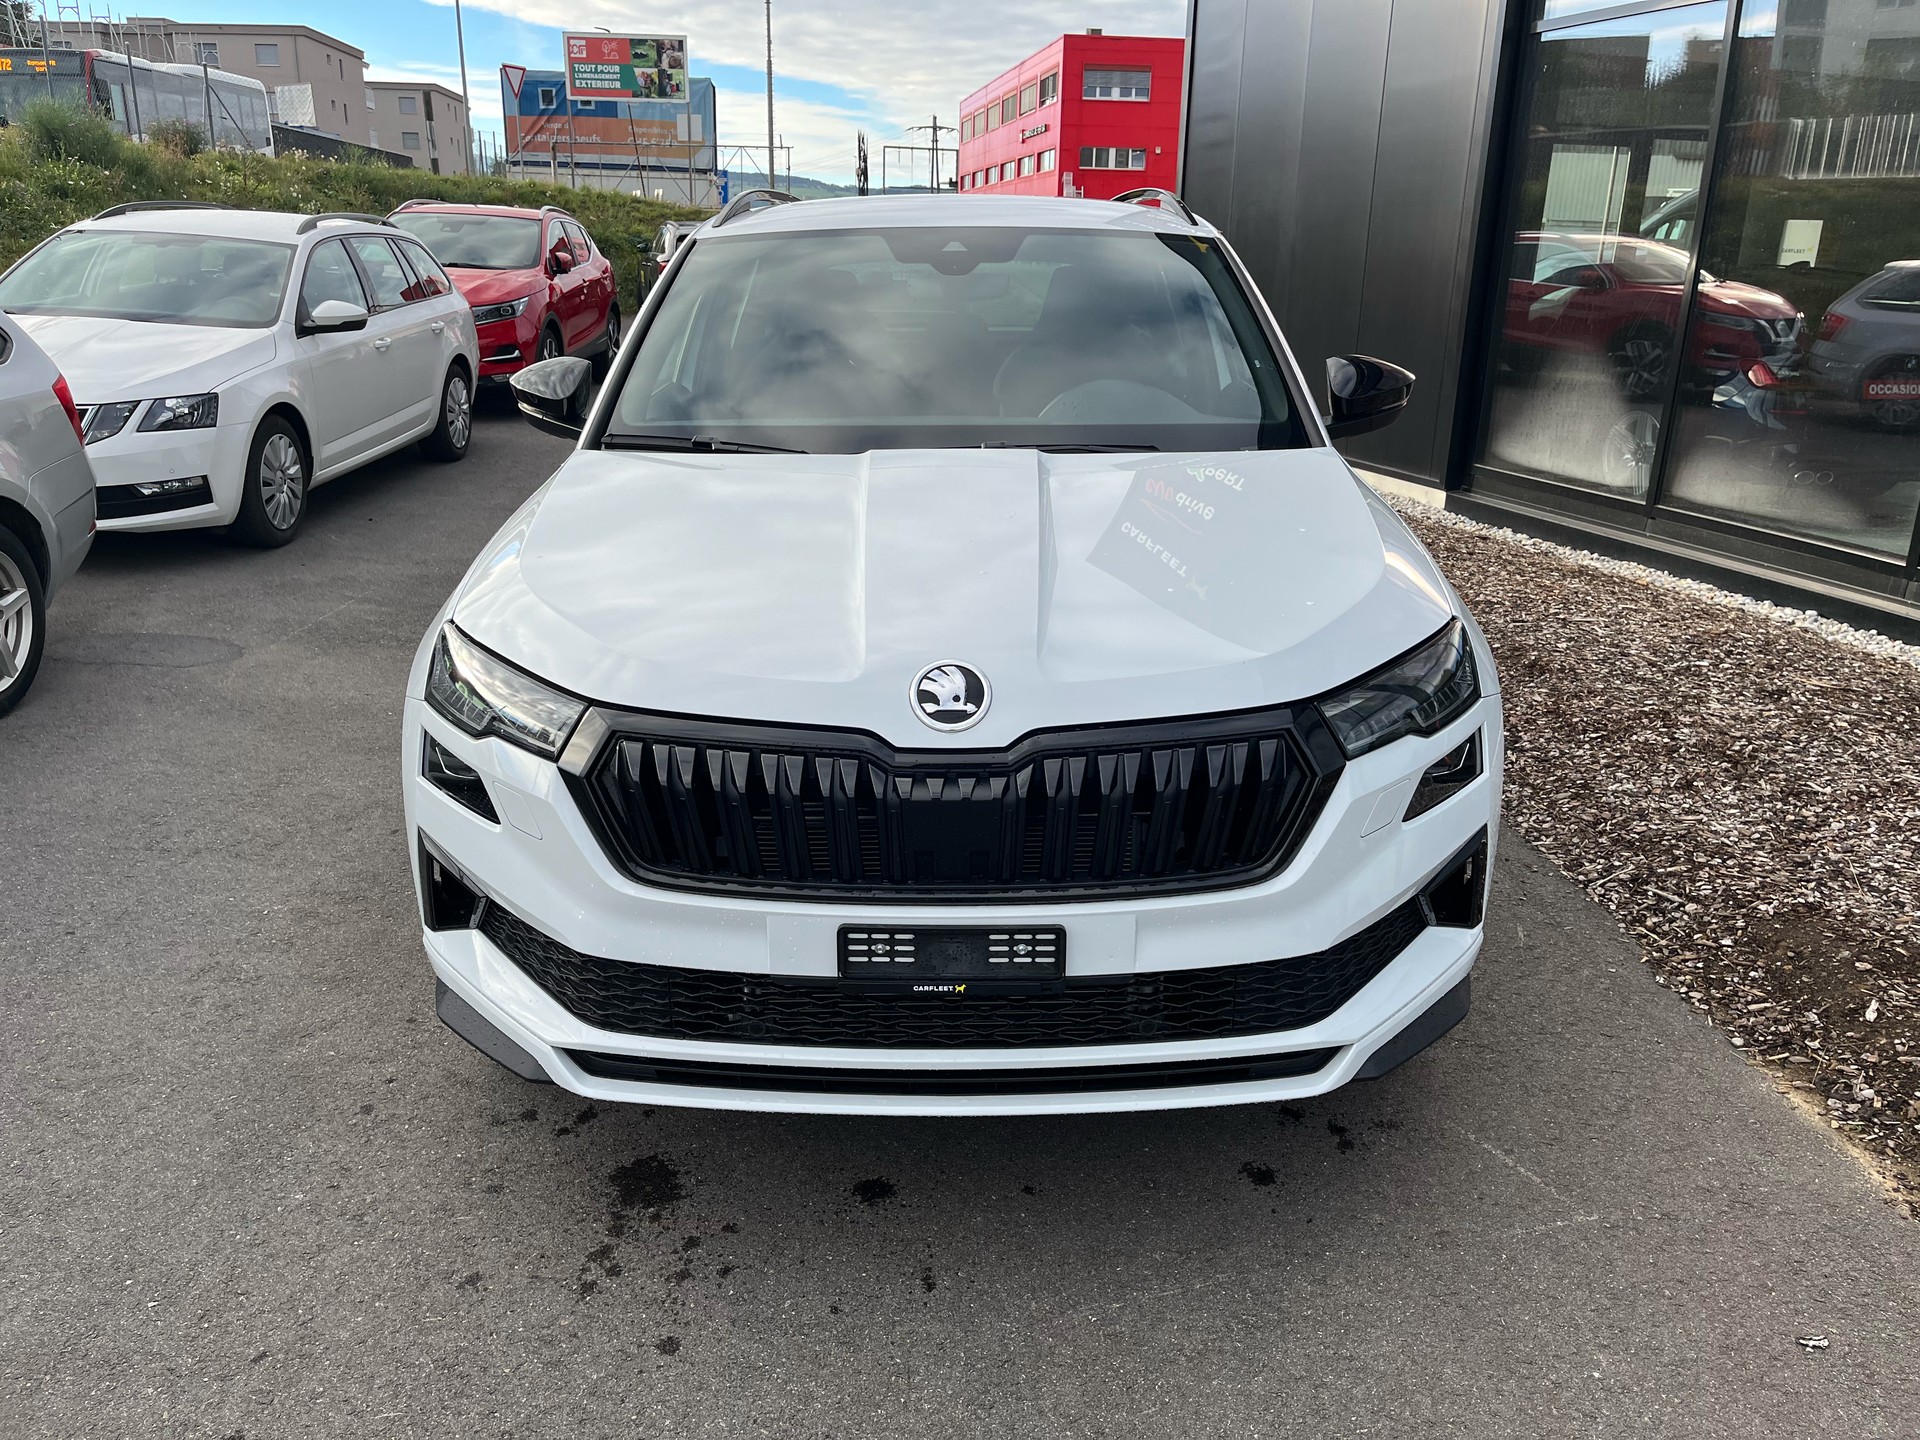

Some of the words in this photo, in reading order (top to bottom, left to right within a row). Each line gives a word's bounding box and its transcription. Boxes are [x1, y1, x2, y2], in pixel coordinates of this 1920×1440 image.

[573, 63, 596, 72] TOUT
[597, 65, 620, 73] POUR
[575, 80, 621, 89] EXTERIEUR
